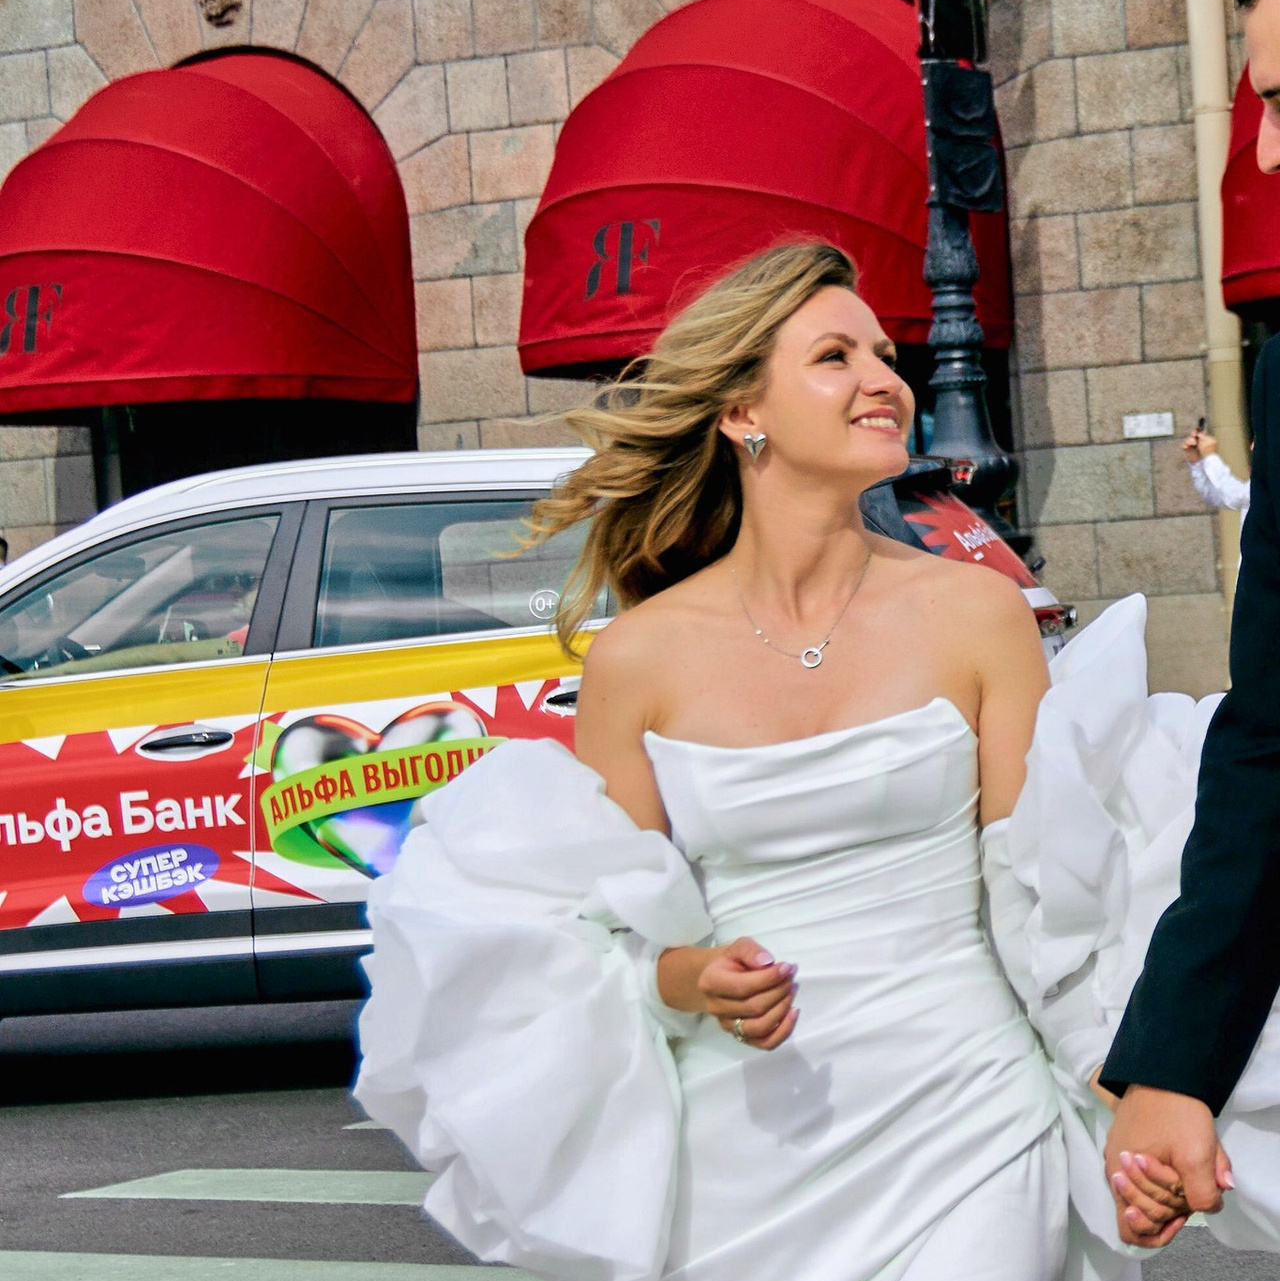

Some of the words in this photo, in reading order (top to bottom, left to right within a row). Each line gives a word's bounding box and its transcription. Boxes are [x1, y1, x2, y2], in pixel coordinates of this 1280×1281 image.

[535, 597, 555, 612] 0+
[269, 768, 357, 827] АЛЬФА
[361, 743, 497, 795] ВЫГОД
[119, 790, 246, 835] Банк
[101, 862, 206, 905] КЭШБЭК
[110, 848, 188, 883] СУПЕР
